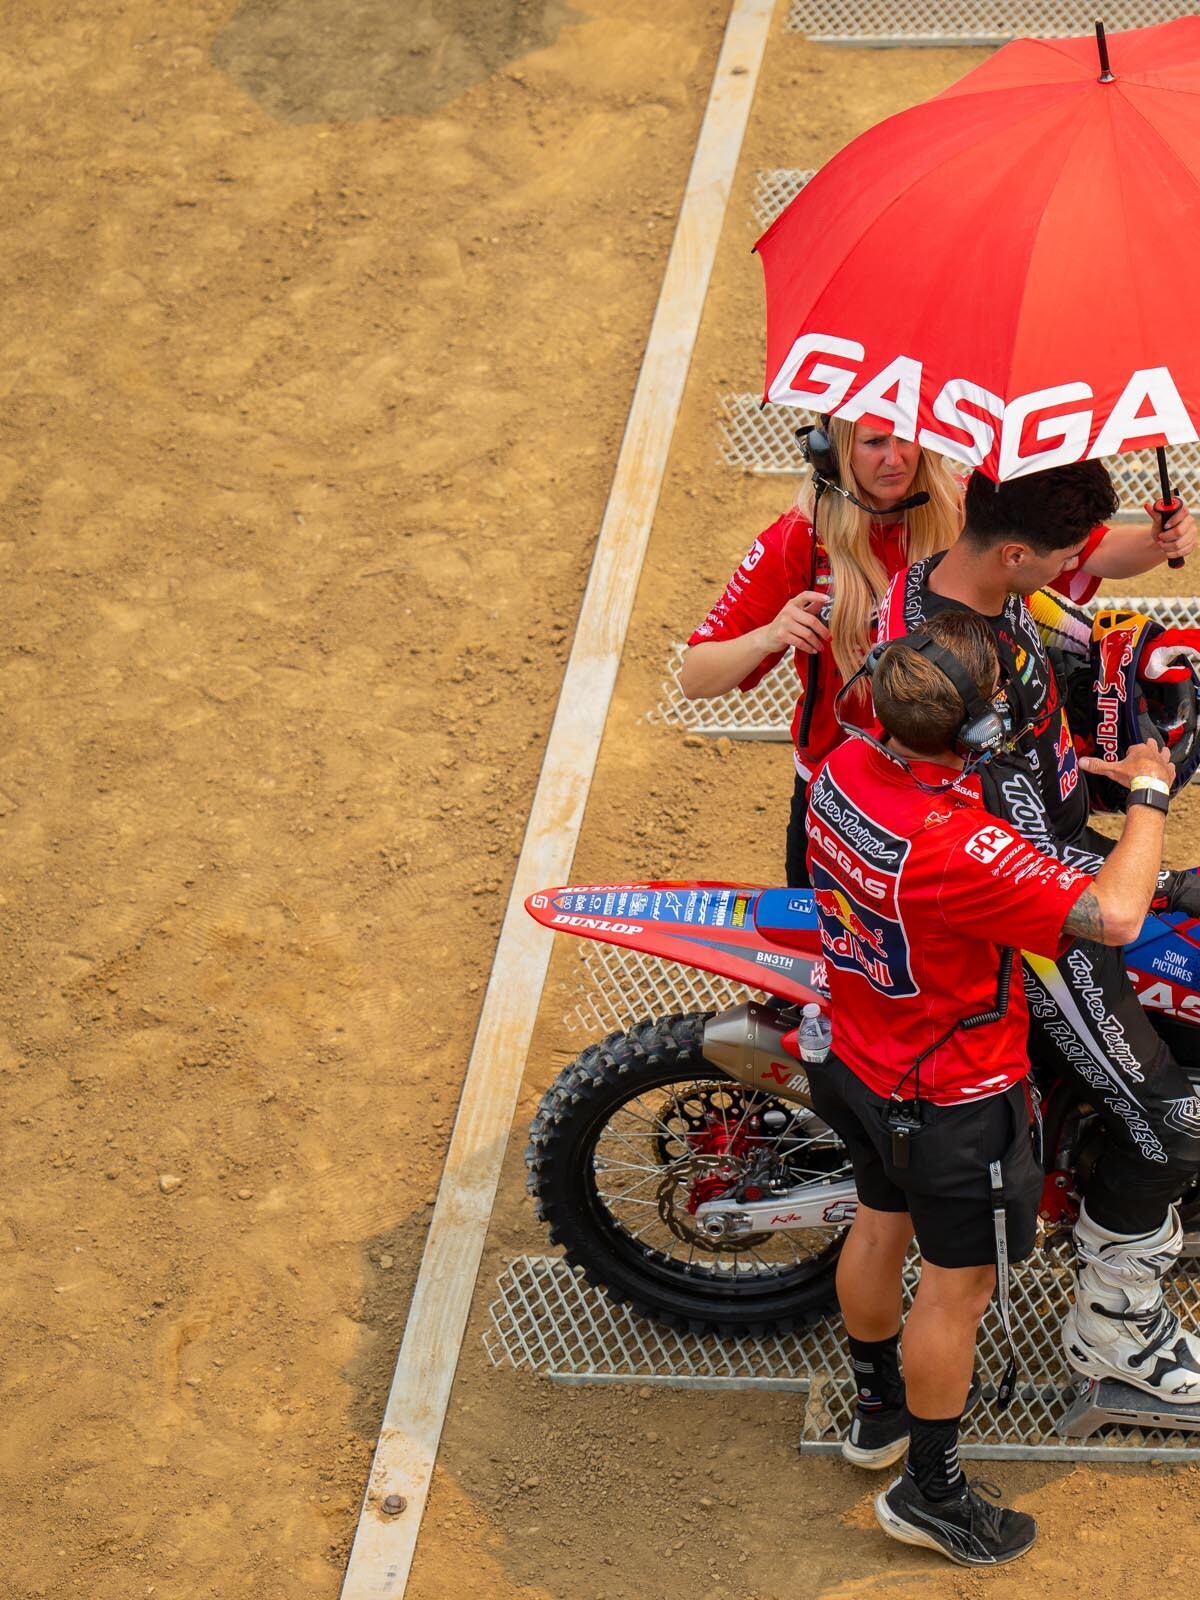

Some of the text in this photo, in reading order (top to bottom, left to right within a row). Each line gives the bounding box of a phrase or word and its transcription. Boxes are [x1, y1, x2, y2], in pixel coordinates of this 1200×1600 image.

[981, 732, 1003, 748] SENA
[1097, 697, 1119, 763] ed Bull
[1060, 769, 1078, 801] Re
[818, 789, 842, 820] Lee
[838, 809, 898, 861] Designs
[616, 892, 628, 916] SENA
[697, 890, 709, 925] RZR
[715, 890, 730, 927] METHOD
[551, 914, 644, 935] DUNLOP
[756, 952, 794, 968] BN3TH
[852, 935, 894, 987] Bull
[1151, 958, 1193, 983] PICTURES
[1164, 950, 1189, 967] SONY
[1067, 949, 1145, 1083] Troy Lee Designs
[1044, 1020, 1118, 1094] FASTEST
[1104, 1098, 1168, 1164] RACERS
